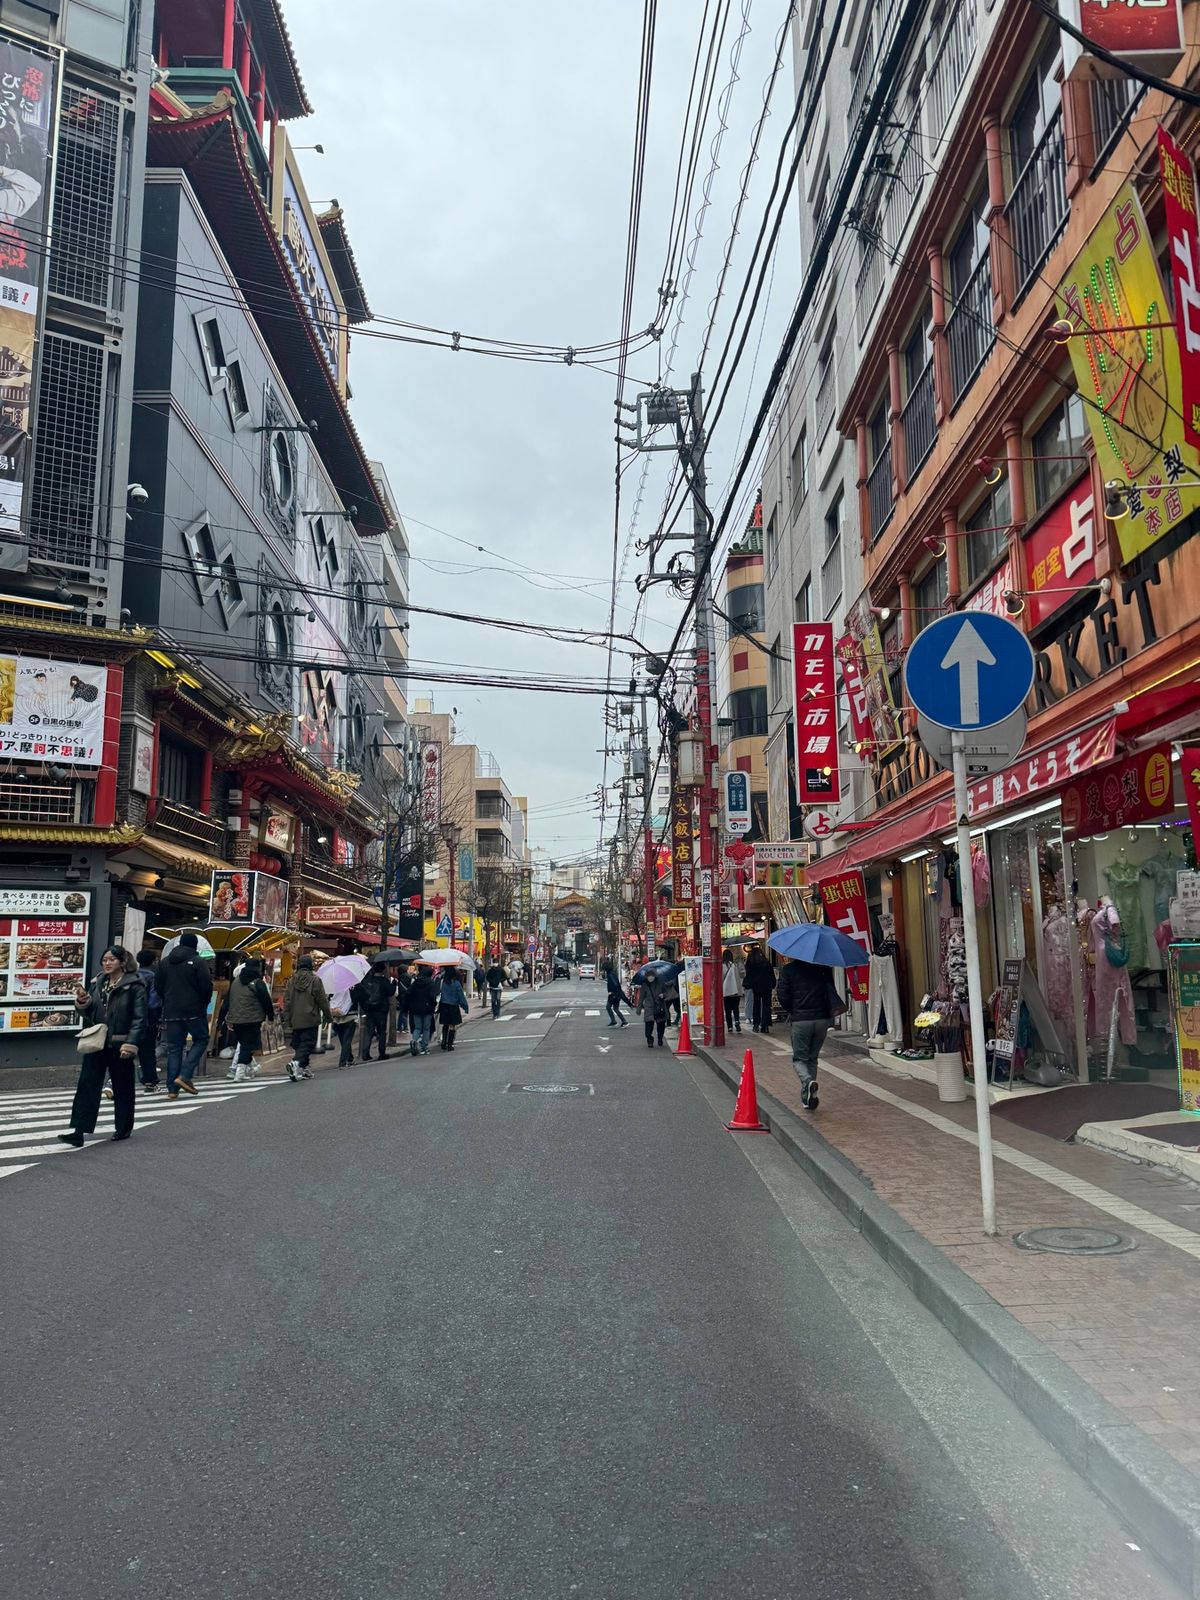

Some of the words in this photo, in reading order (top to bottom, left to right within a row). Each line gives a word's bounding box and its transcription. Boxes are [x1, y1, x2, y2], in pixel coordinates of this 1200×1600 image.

[1113, 199, 1141, 265] 占
[1144, 487, 1183, 535] 本店
[1062, 493, 1094, 579] 占
[1031, 545, 1062, 592] 個室
[803, 633, 832, 754] カモメ市場
[0, 740, 94, 759] ア、摩訶不思議!
[1149, 758, 1167, 800] 占
[812, 812, 831, 835] 占
[702, 871, 711, 925] 木戸接骨院
